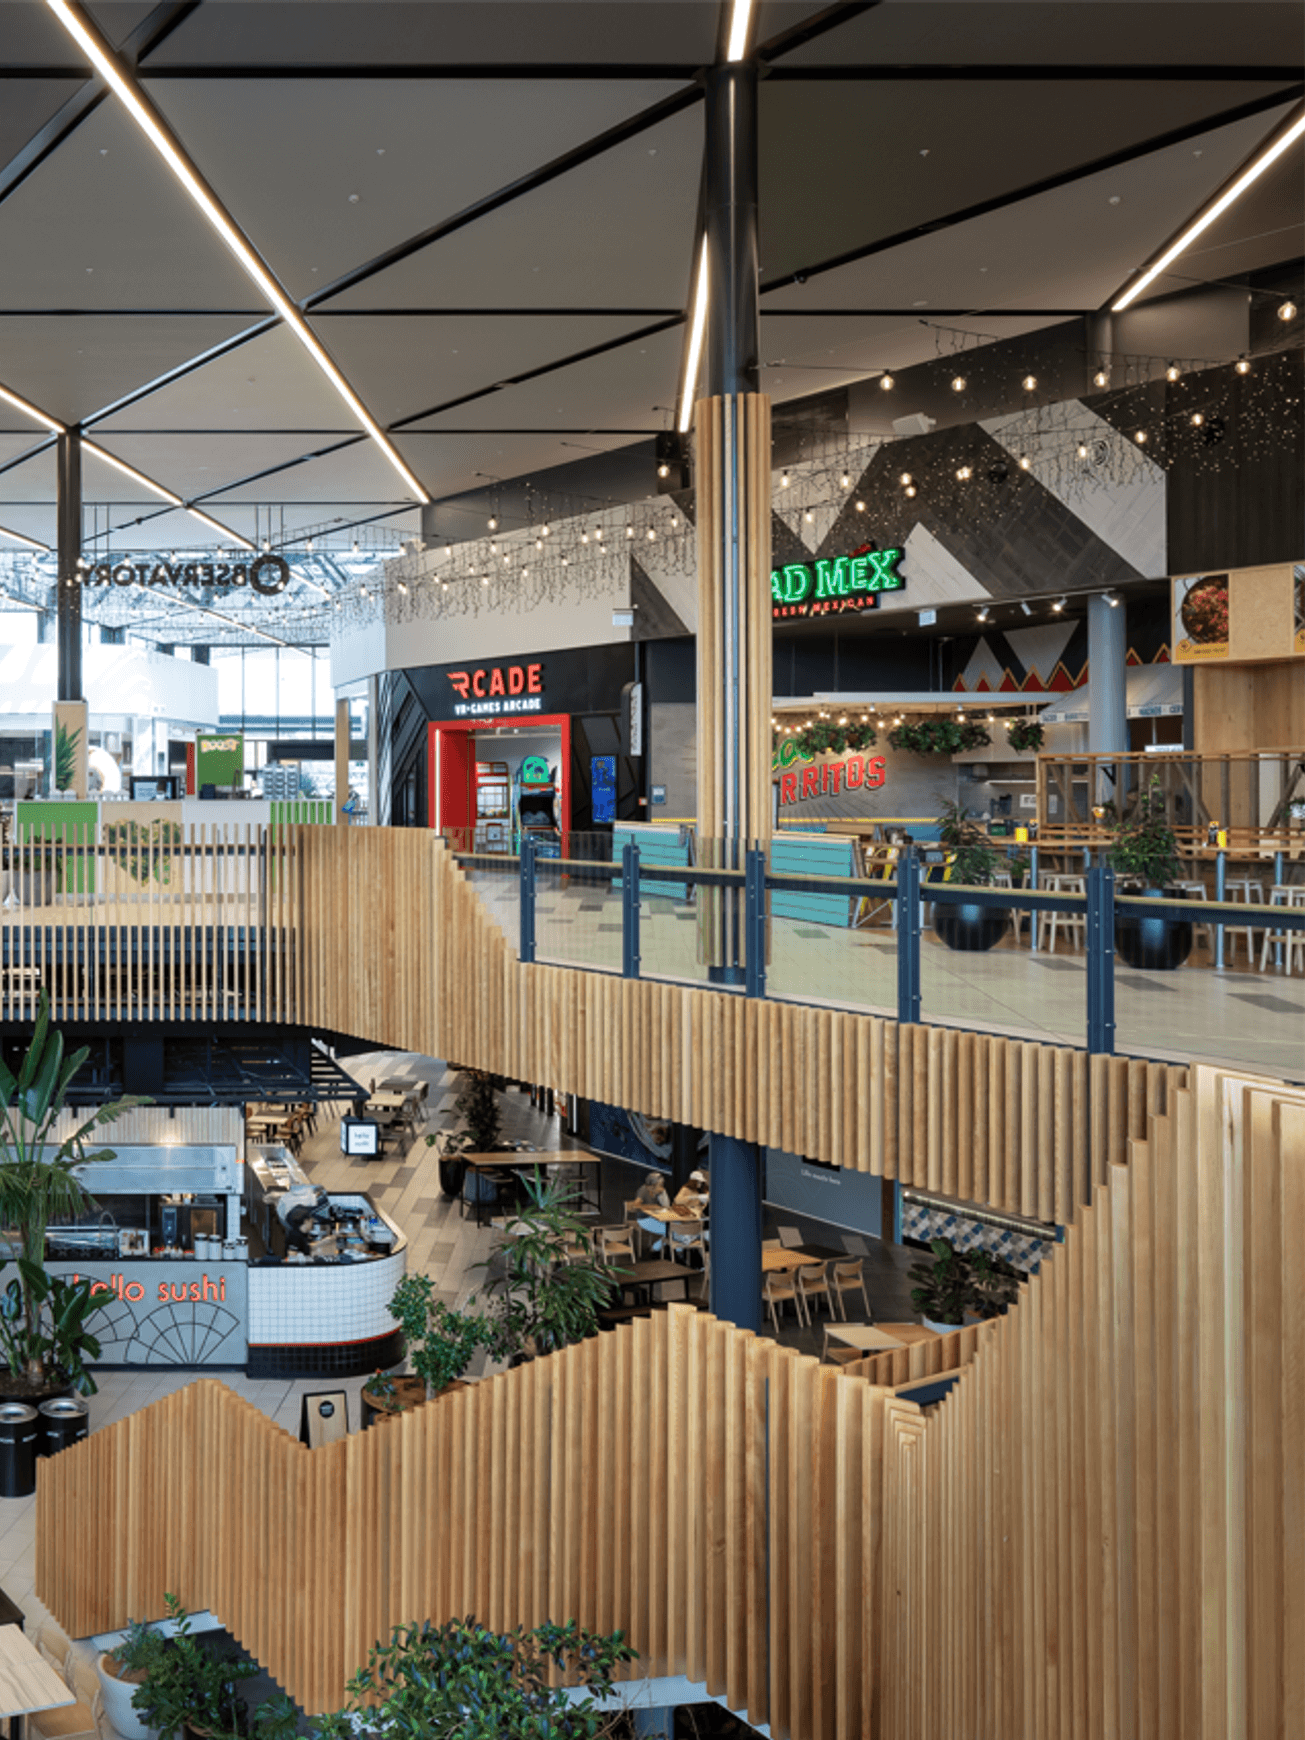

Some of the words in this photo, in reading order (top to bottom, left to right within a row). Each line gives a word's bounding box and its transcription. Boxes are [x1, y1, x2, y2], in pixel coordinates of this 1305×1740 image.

[815, 549, 901, 598] MEX
[812, 595, 874, 613] MEXICAN
[447, 663, 542, 699] RCADE
[503, 697, 541, 712] ARCADE
[73, 1273, 145, 1302] llo
[158, 1273, 226, 1302] sushi
